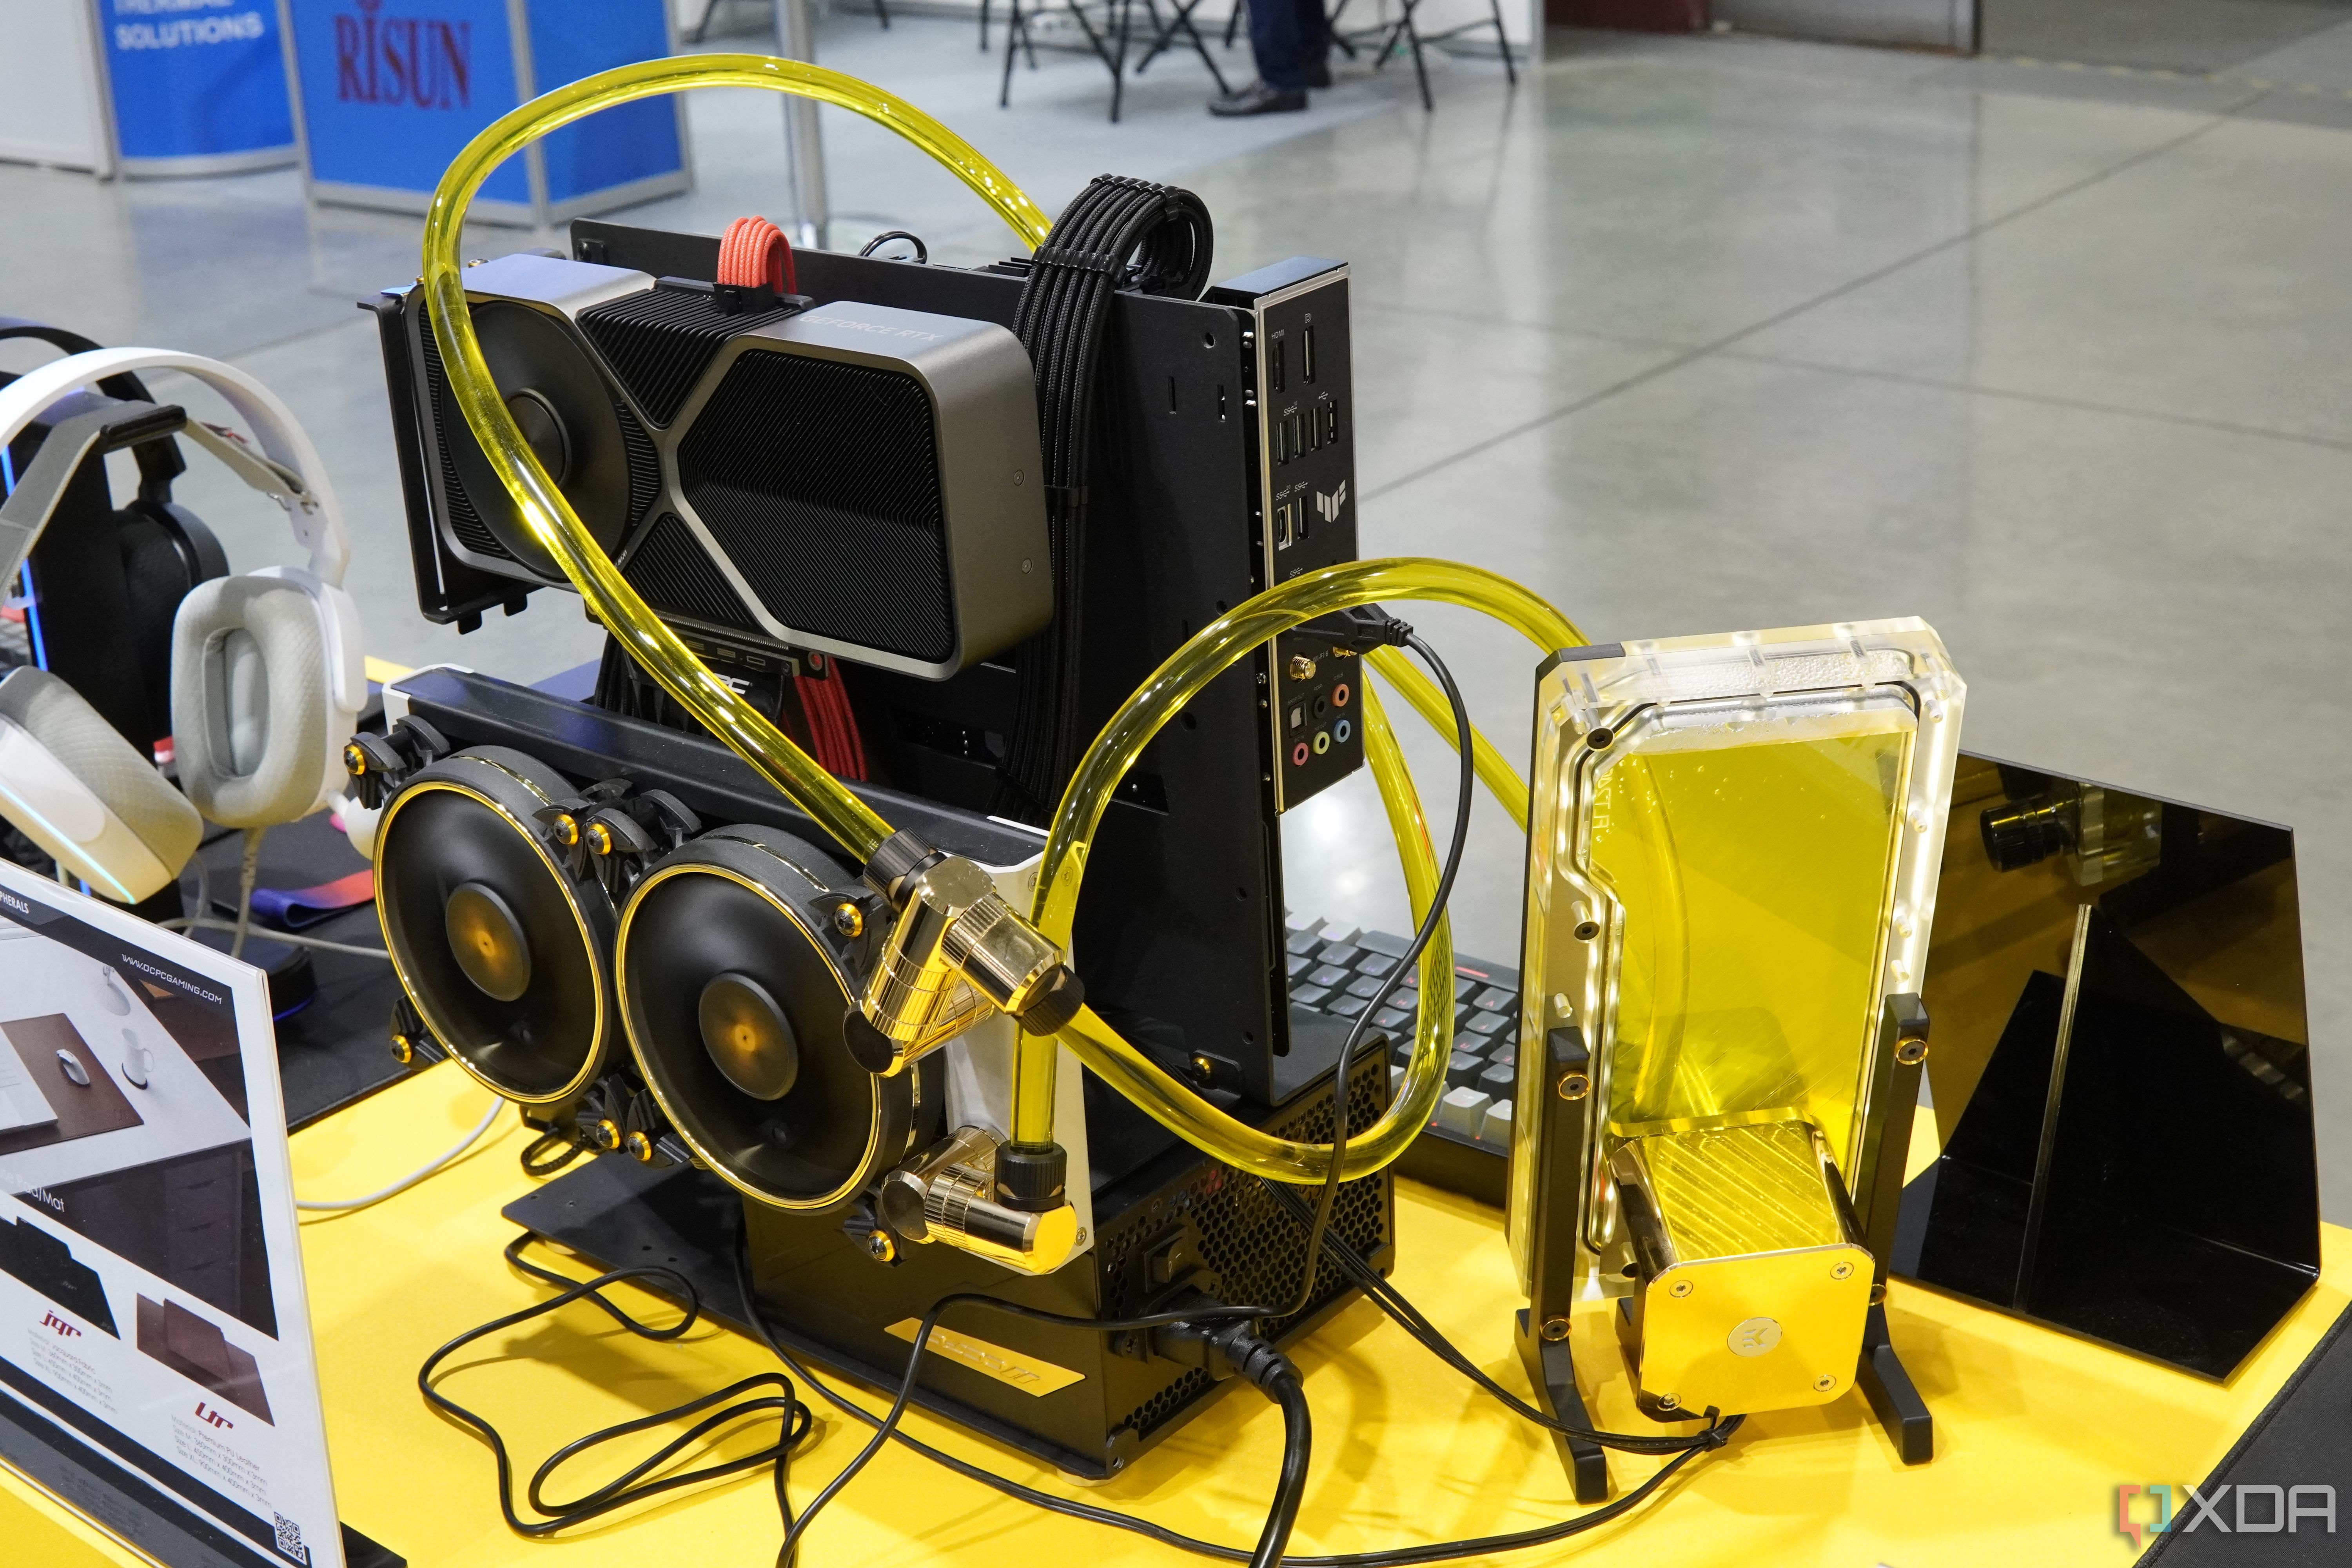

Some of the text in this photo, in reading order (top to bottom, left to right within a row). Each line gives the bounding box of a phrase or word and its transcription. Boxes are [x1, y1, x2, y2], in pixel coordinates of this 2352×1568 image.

[113, 11, 263, 50] SOLUTIONS
[799, 315, 944, 341] GEFORCE RTX
[1271, 329, 1285, 340] HDMI
[122, 953, 222, 1005] WWW.OCPCGAMING.COM
